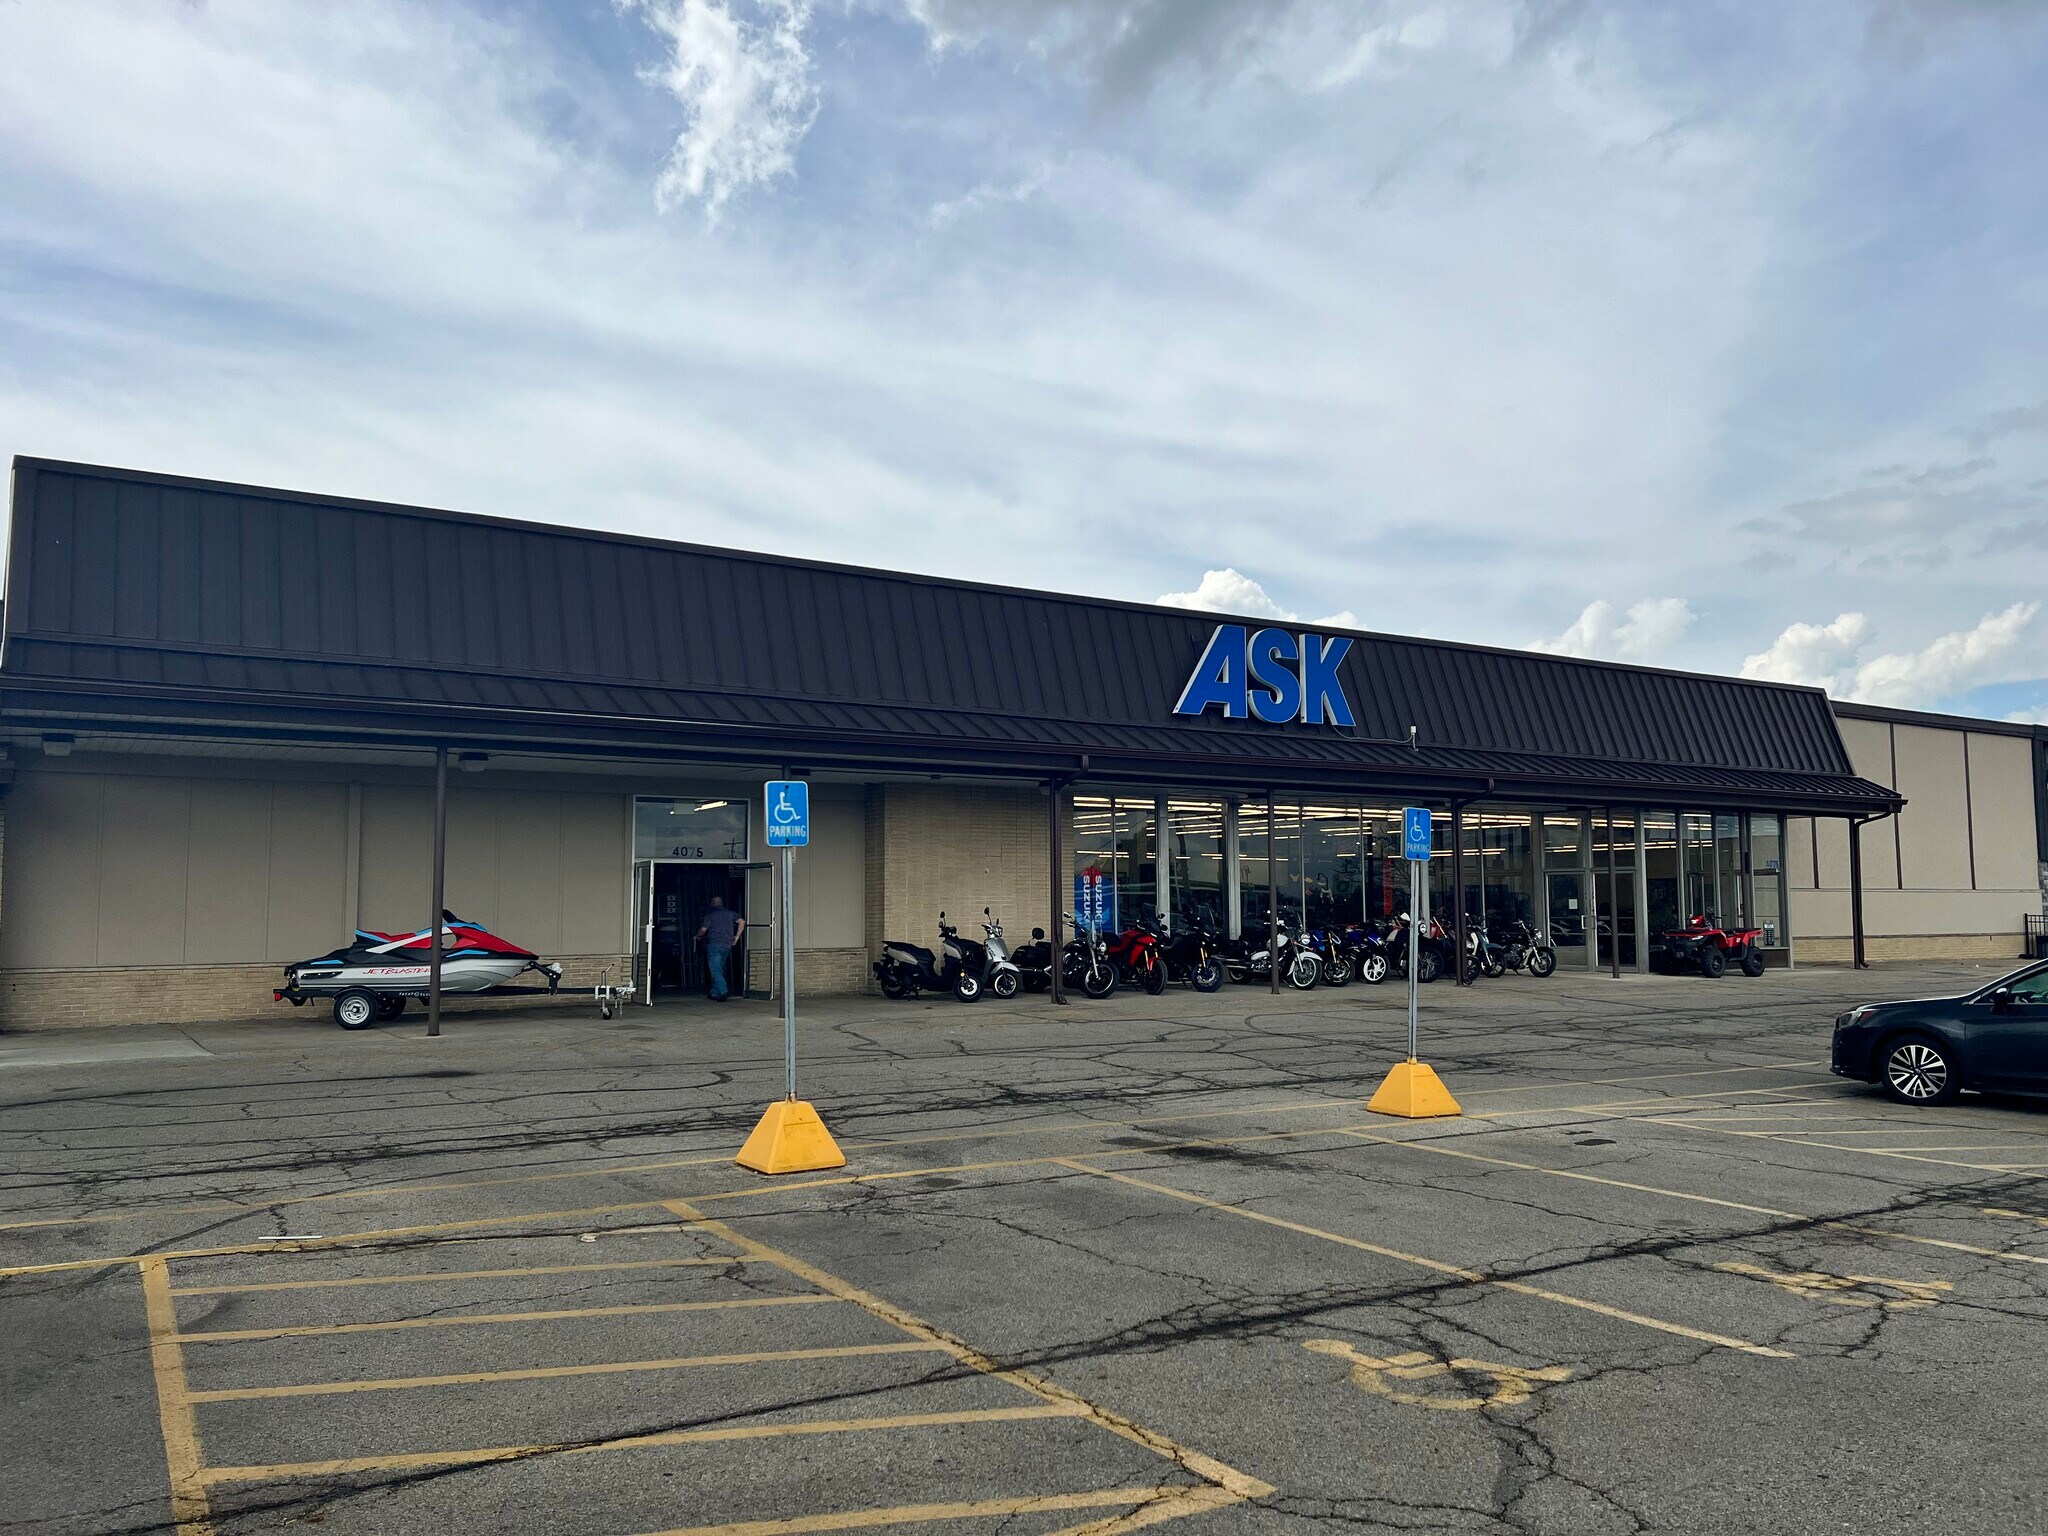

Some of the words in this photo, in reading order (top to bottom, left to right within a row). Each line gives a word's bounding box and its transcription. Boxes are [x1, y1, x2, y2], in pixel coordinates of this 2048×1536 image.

[1172, 624, 1356, 727] ASK
[769, 825, 807, 837] PARKING
[672, 847, 704, 857] 4075
[1407, 842, 1430, 853] PARKING
[1083, 875, 1091, 921] SUZUK
[1095, 875, 1103, 923] SUZUKI
